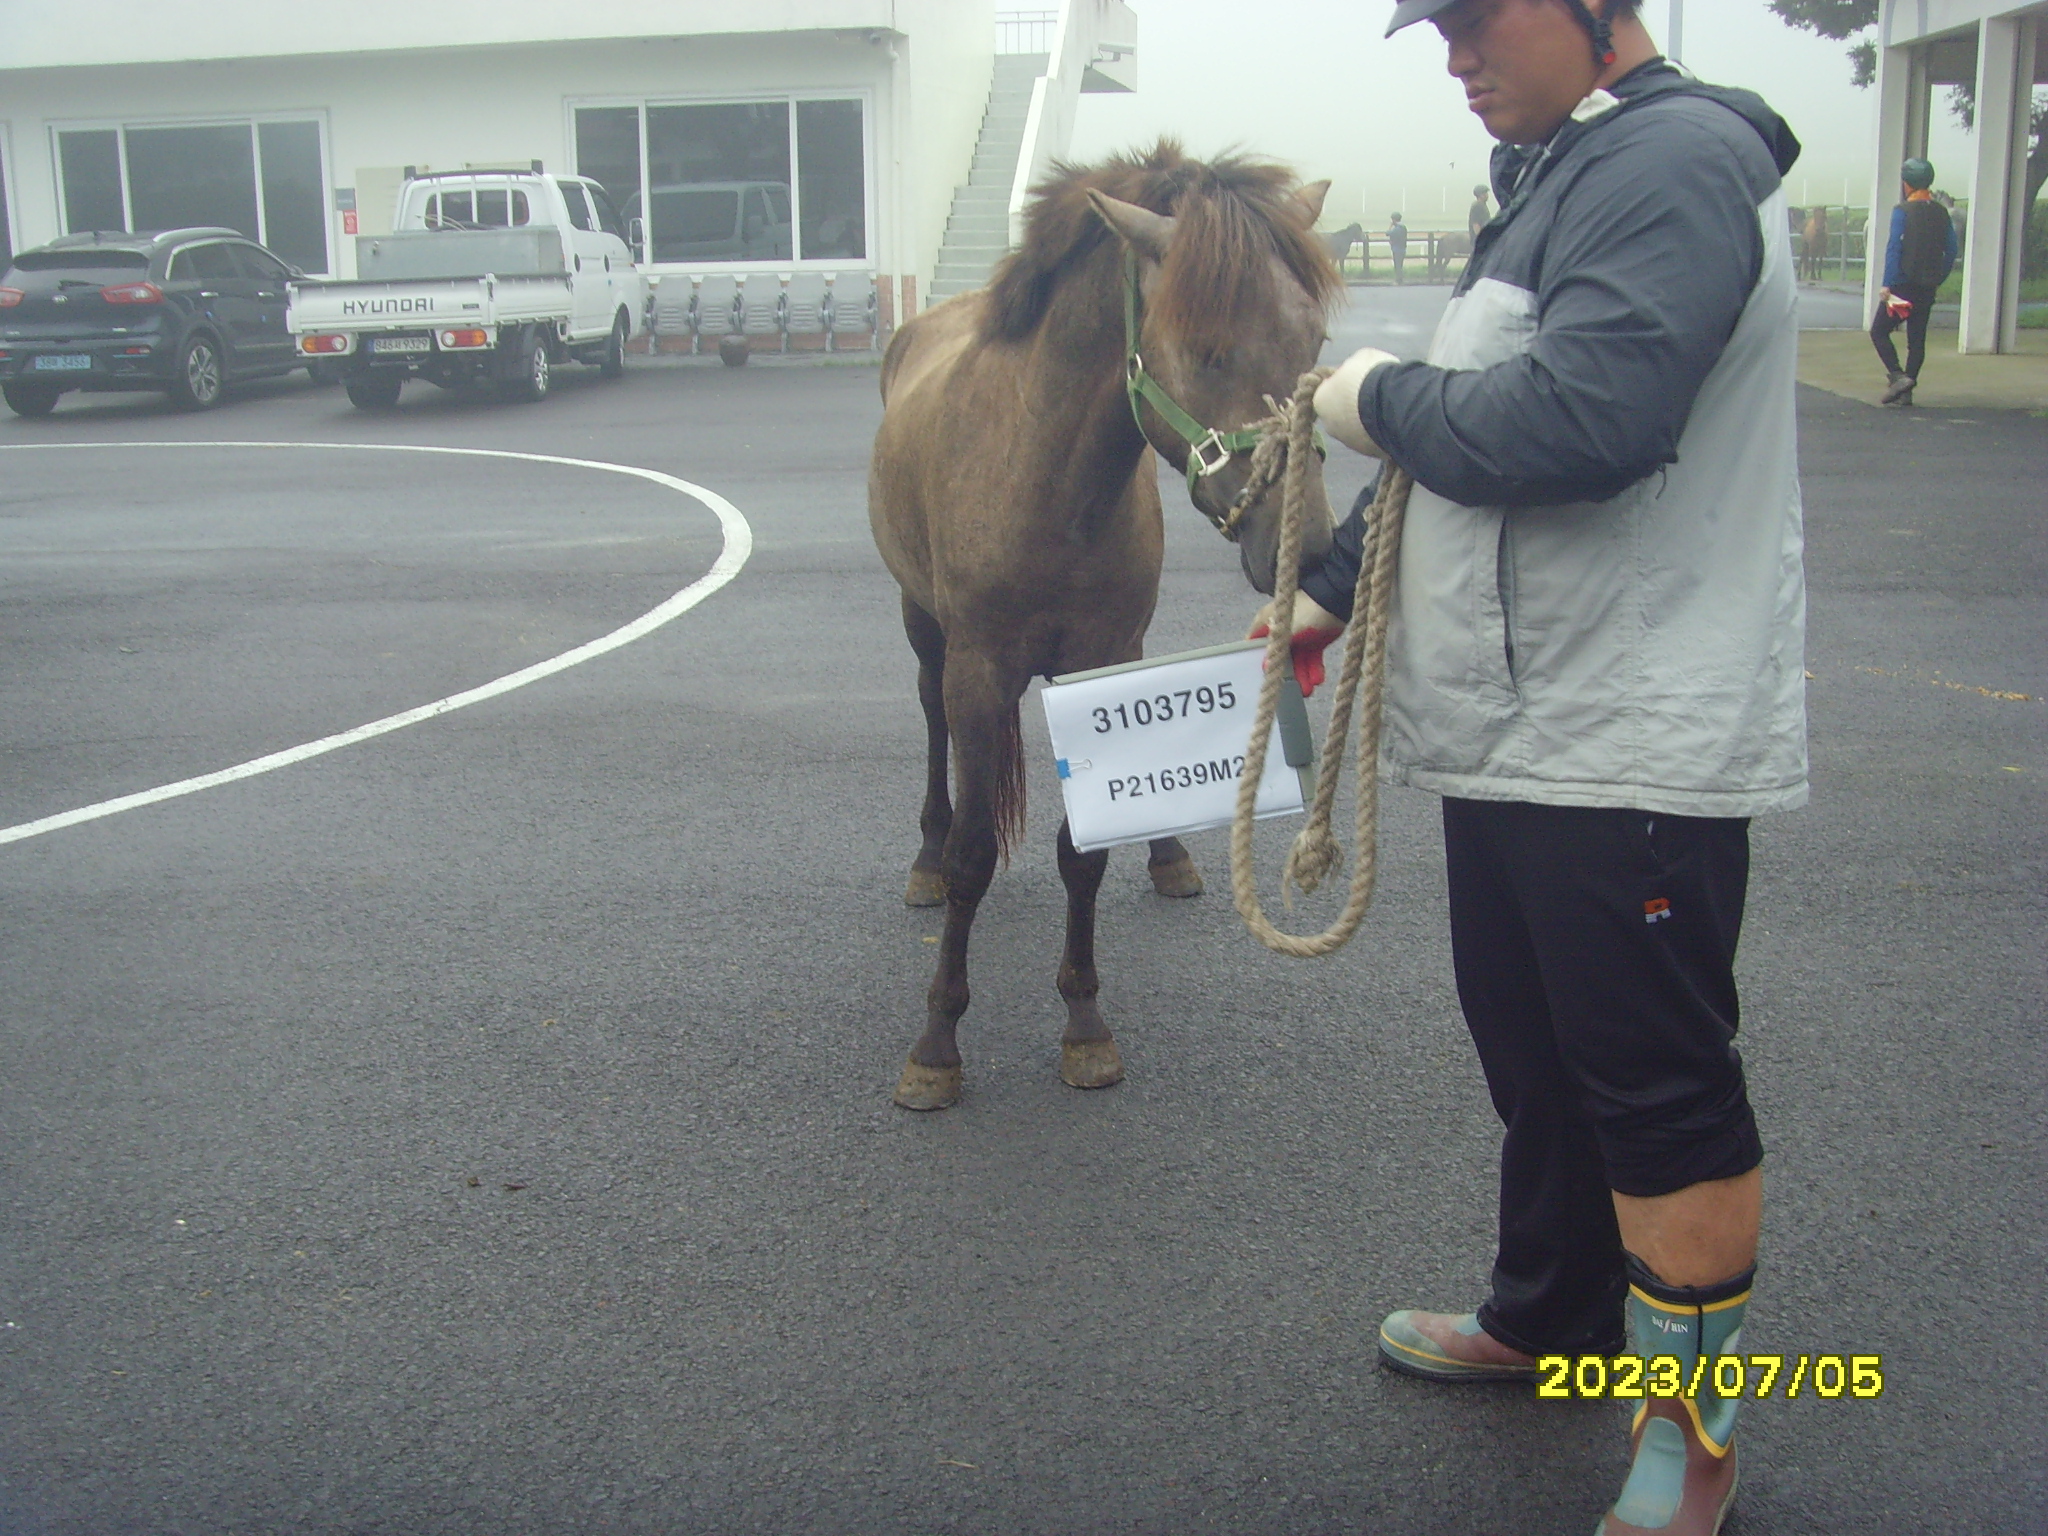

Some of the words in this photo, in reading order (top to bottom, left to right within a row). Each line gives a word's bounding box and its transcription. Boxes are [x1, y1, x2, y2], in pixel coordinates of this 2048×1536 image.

[343, 297, 434, 315] HYUNDAI
[1091, 681, 1237, 733] 3103795
[1107, 755, 1246, 801] P21639M2
